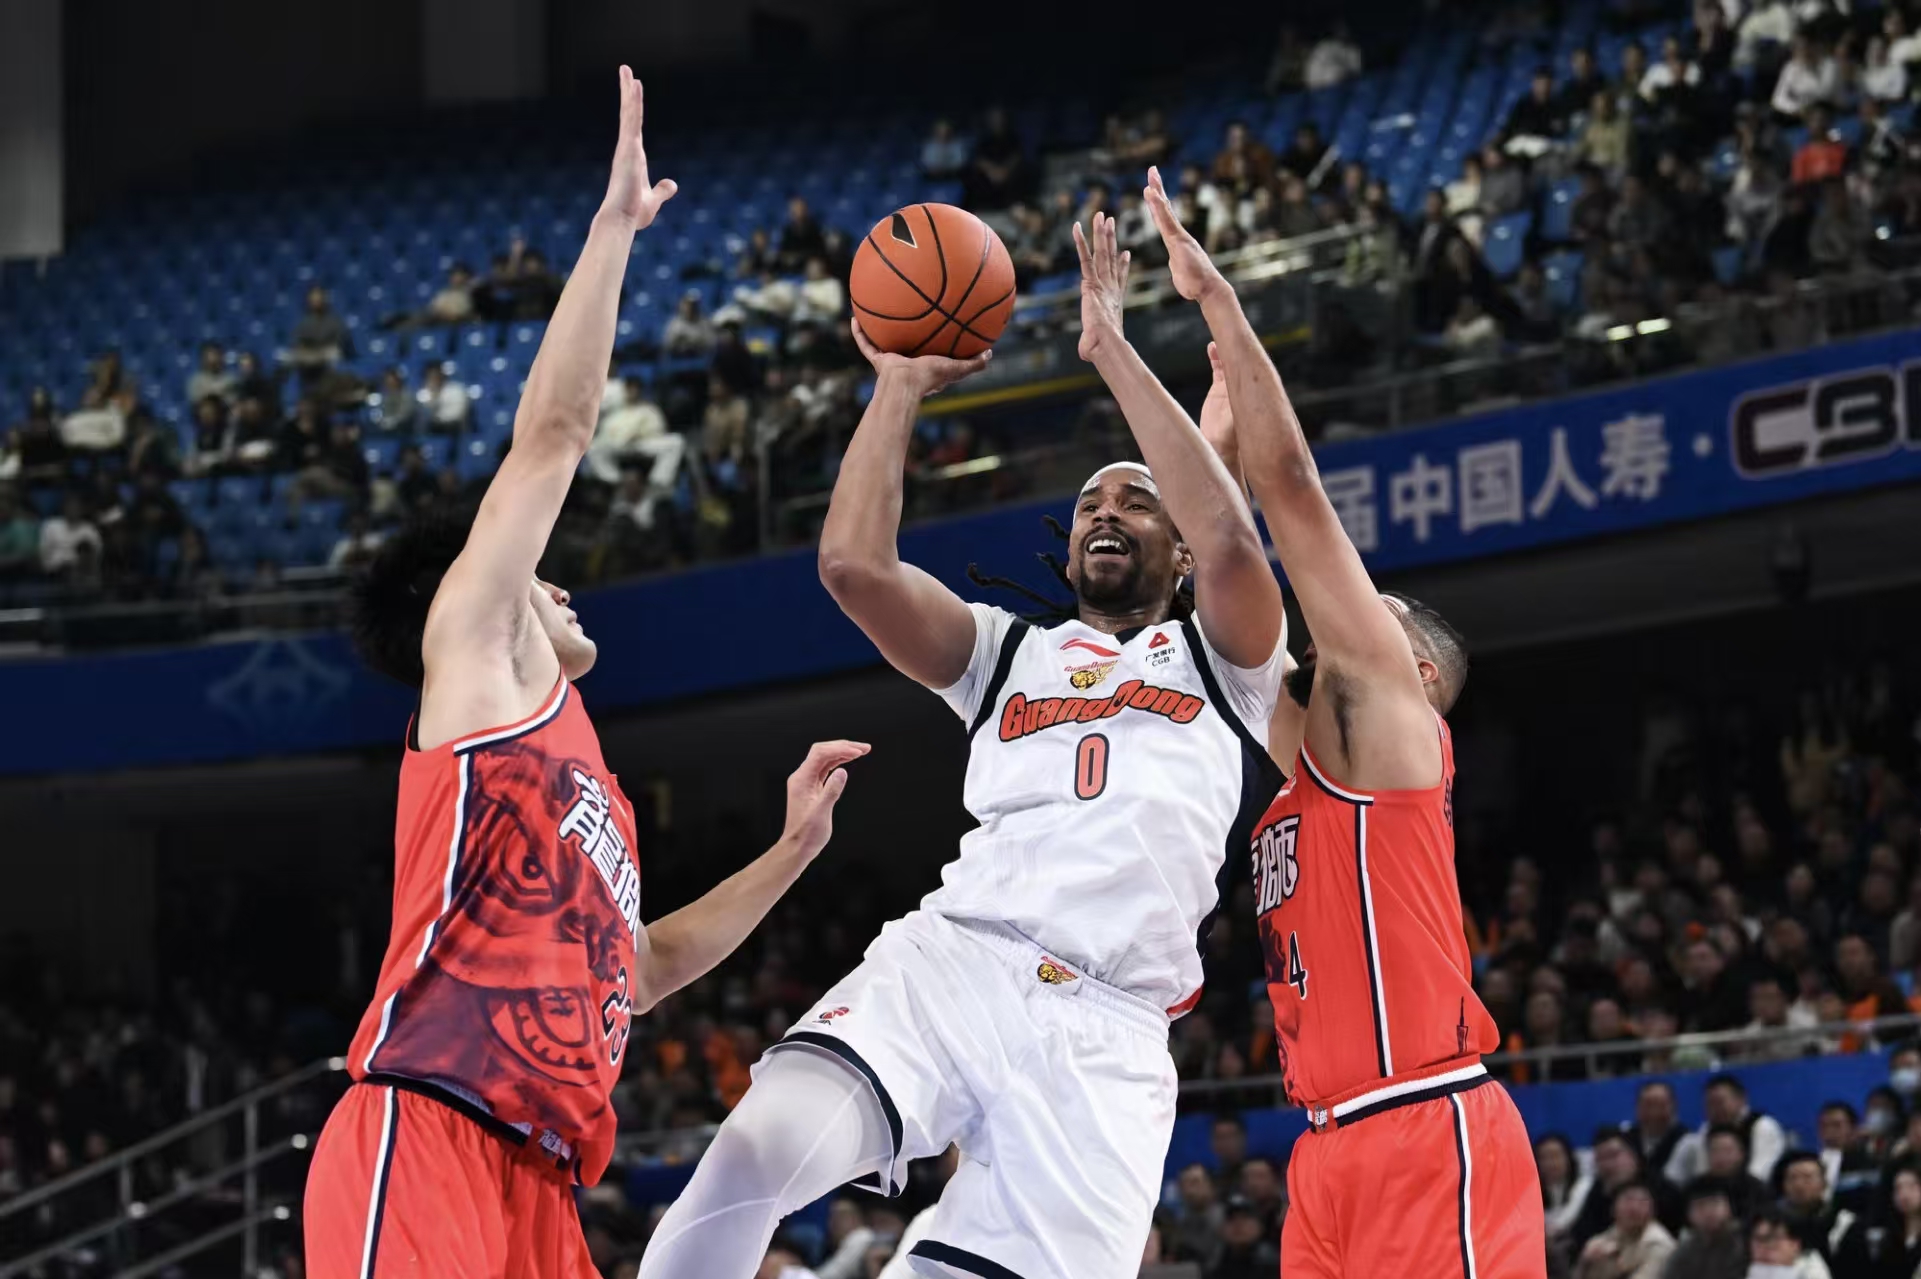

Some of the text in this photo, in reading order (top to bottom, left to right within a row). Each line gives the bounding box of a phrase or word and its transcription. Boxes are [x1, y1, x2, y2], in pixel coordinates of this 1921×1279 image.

[1152, 656, 1170, 667] CGB
[999, 680, 1205, 742] GuangDong
[1074, 733, 1109, 800] 0
